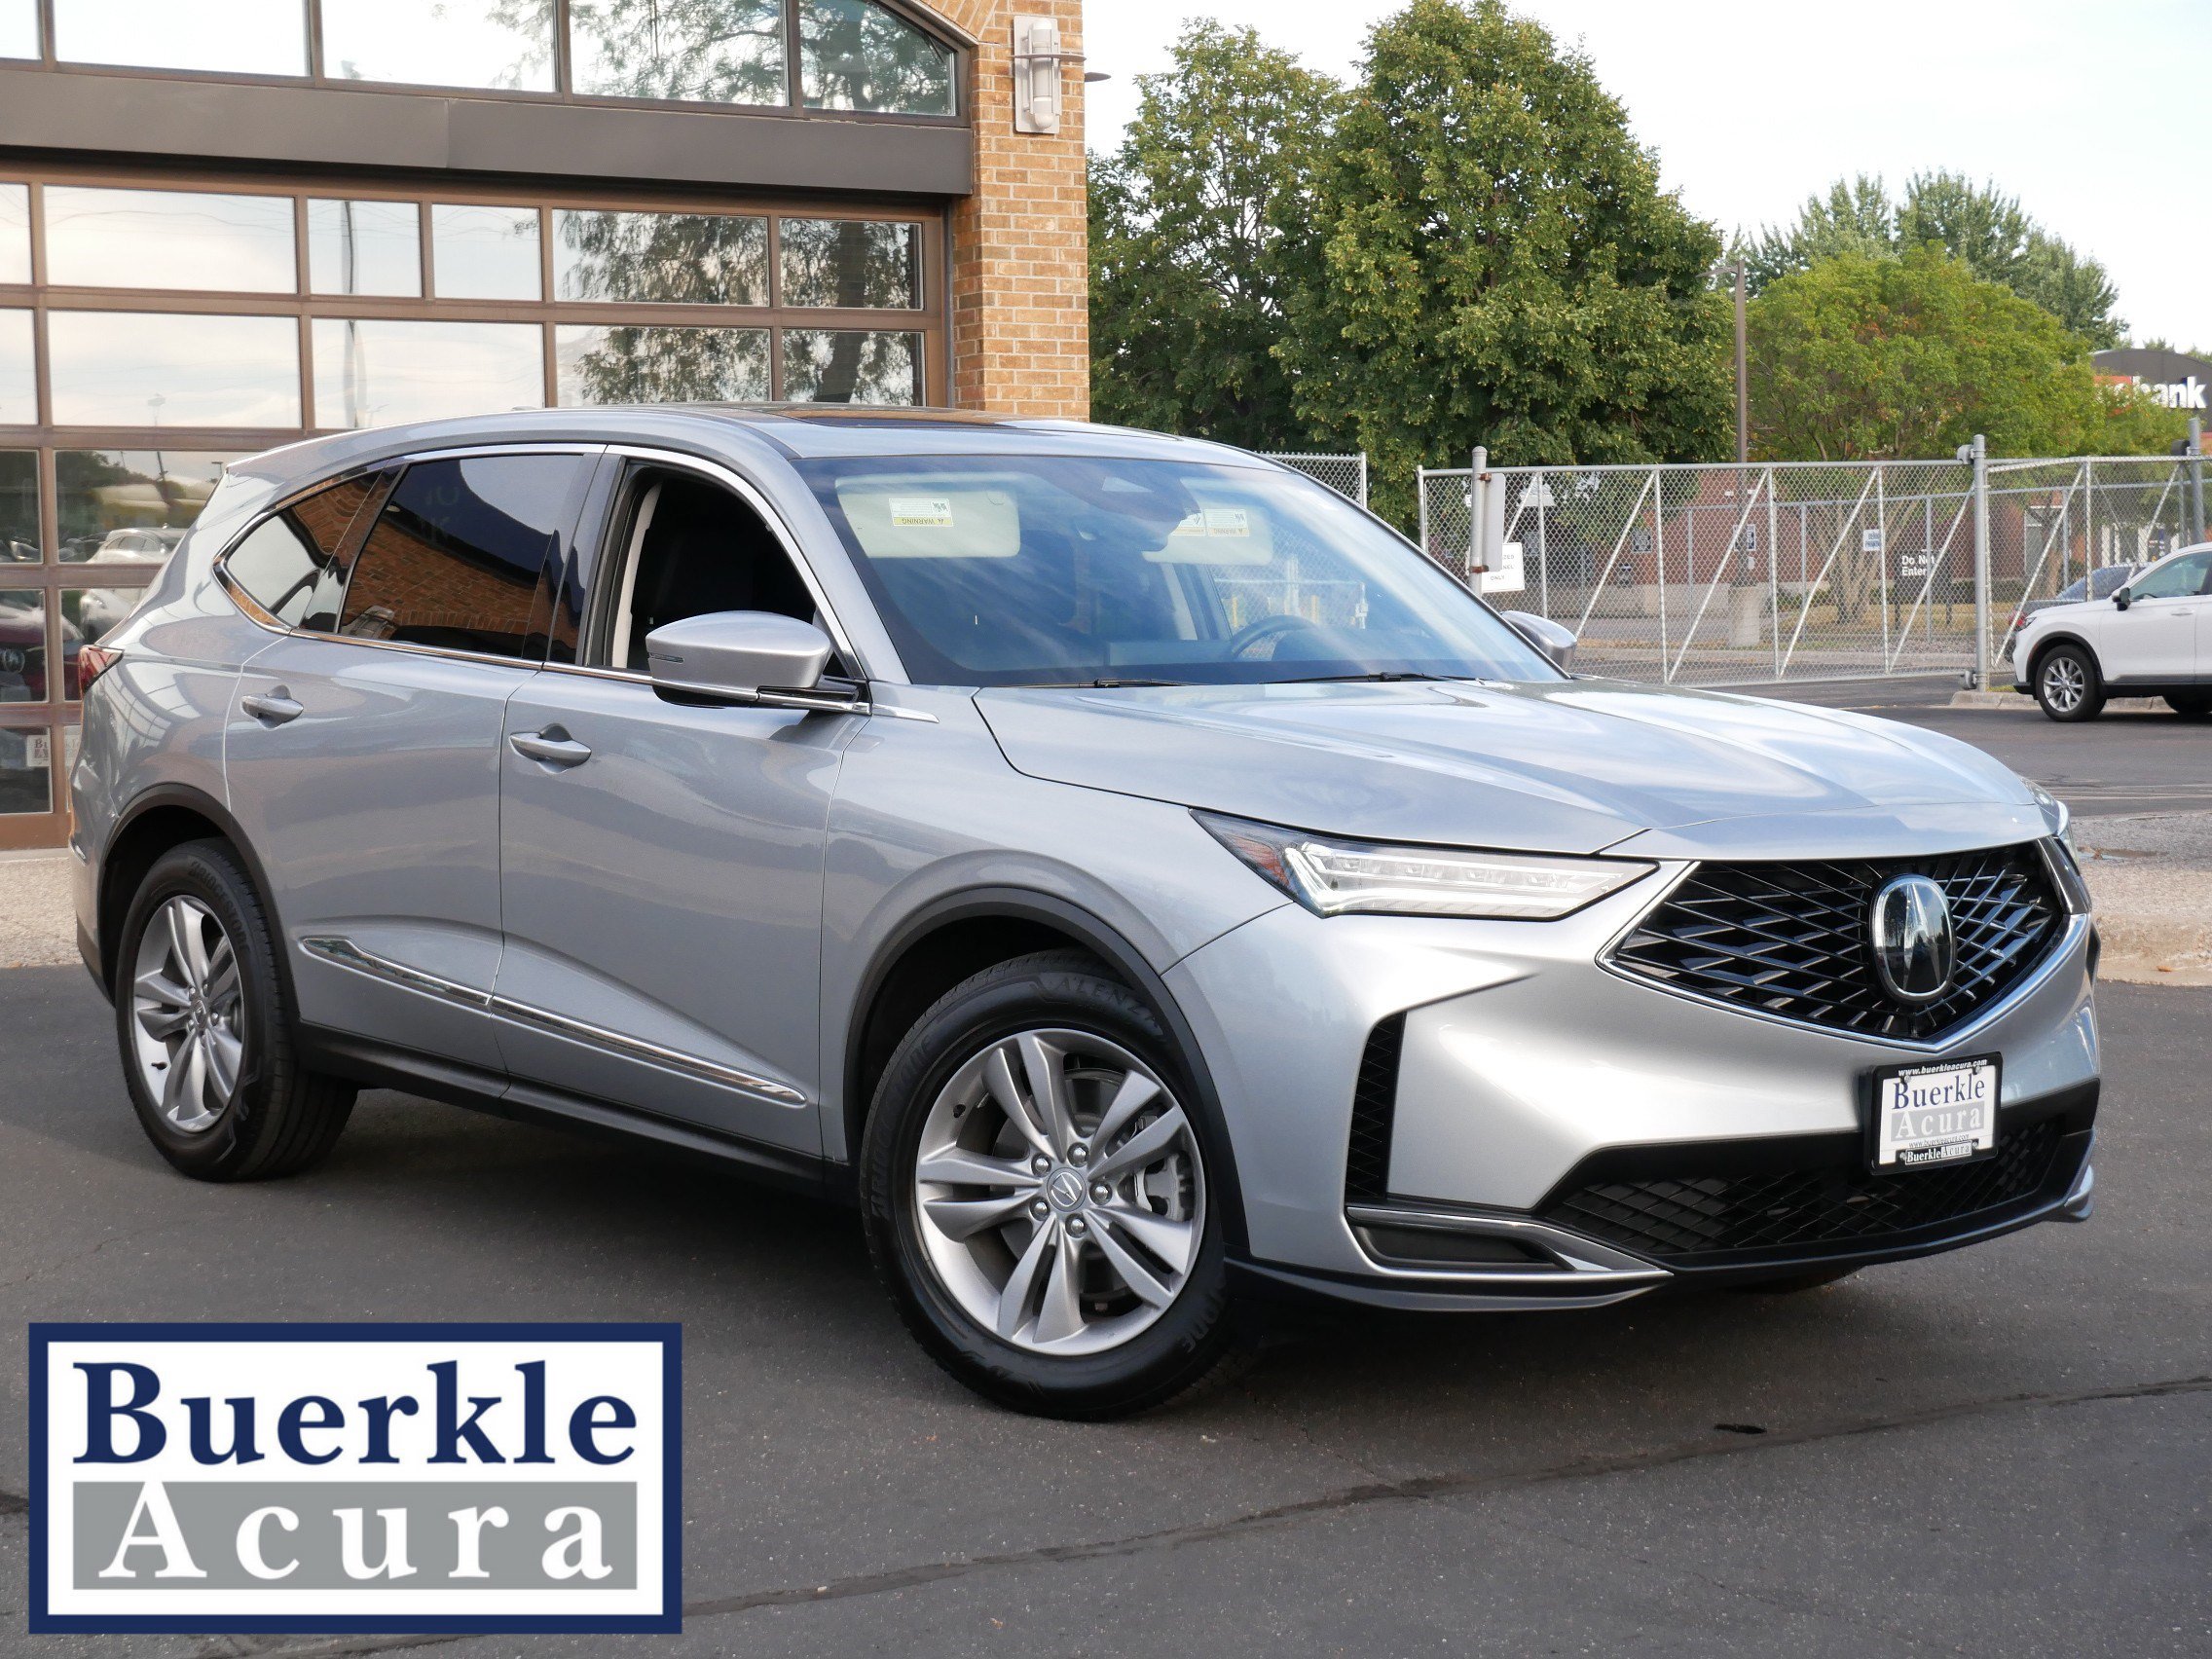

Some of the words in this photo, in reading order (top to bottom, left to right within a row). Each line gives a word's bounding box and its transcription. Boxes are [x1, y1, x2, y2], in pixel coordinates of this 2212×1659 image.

[1901, 555, 1915, 565] Do
[1901, 566, 1927, 575] Enter
[1893, 1073, 1986, 1110] Buerkle
[1895, 1107, 1982, 1139] Acura
